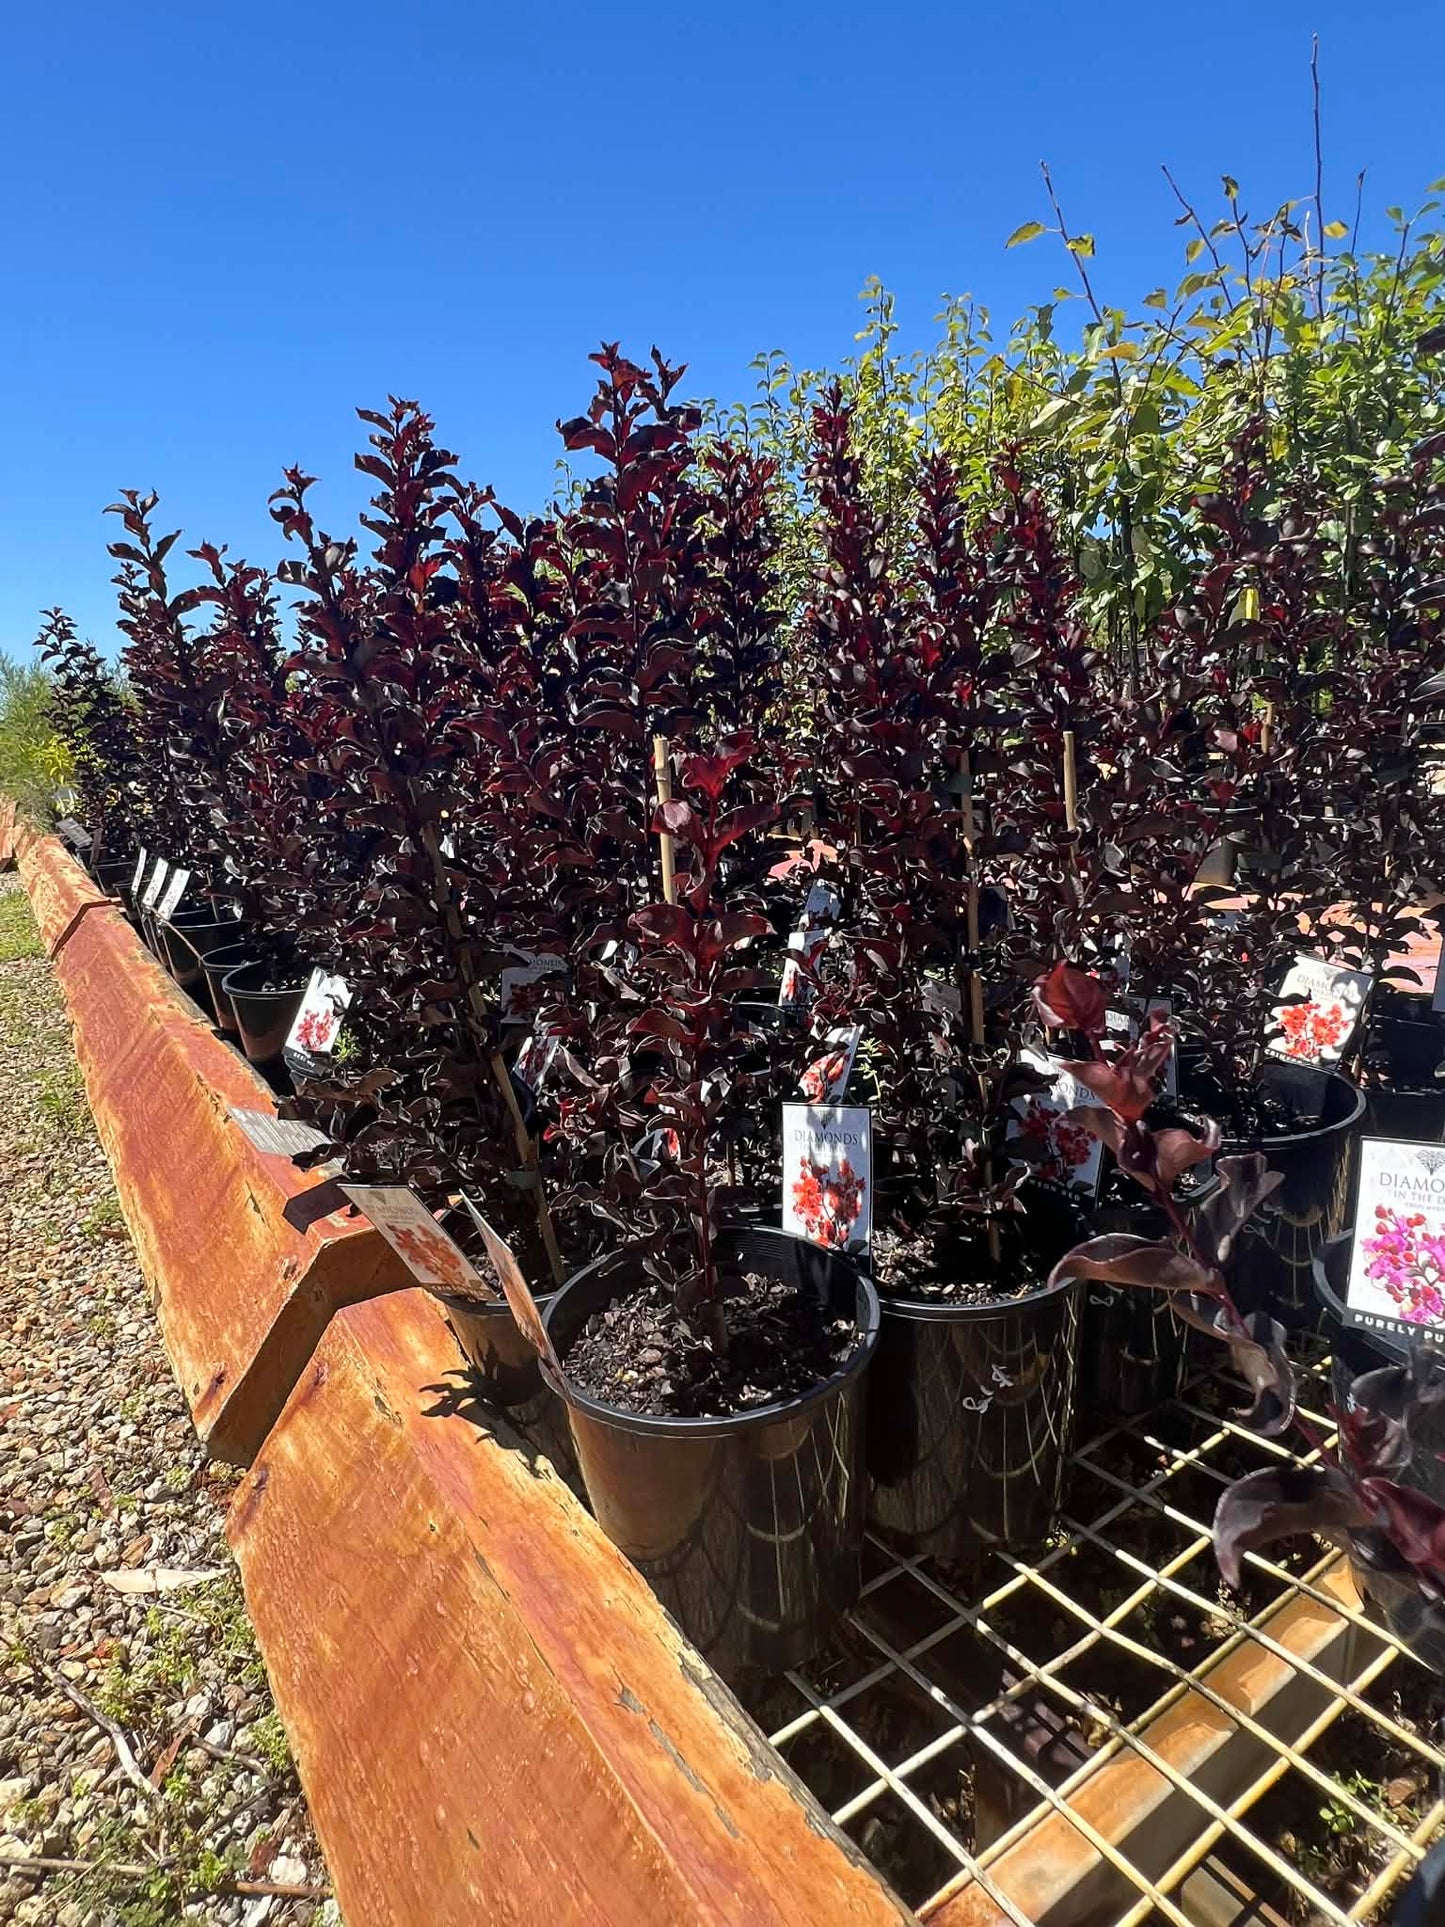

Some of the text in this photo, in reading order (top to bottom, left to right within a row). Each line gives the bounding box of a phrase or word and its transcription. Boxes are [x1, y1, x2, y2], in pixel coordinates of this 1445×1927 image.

[794, 1129, 859, 1145] DIAMONDS
[1380, 1171, 1445, 1193] DIAMO
[1354, 1313, 1416, 1337] PURELY
